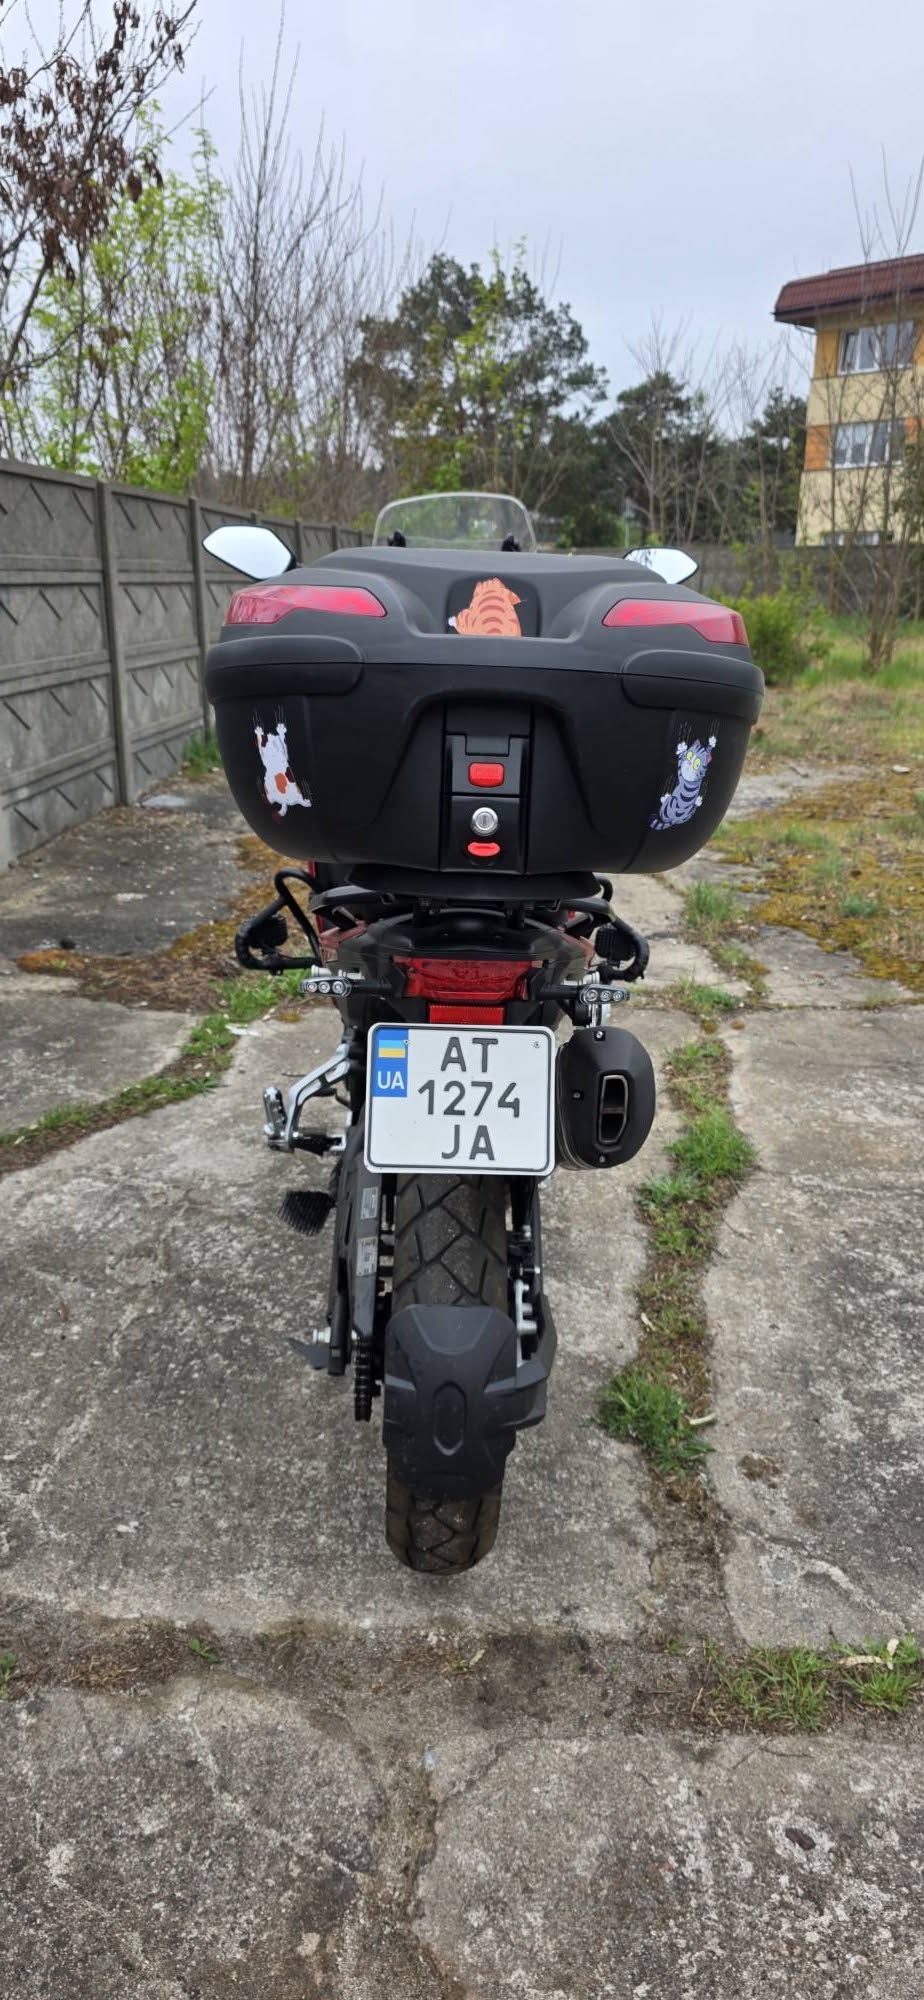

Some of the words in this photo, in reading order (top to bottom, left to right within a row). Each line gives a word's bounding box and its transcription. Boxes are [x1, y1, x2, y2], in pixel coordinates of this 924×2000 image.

[440, 1036, 499, 1073] AT
[377, 1071, 405, 1090] UA
[418, 1079, 520, 1118] 1274
[441, 1124, 495, 1161] JA
